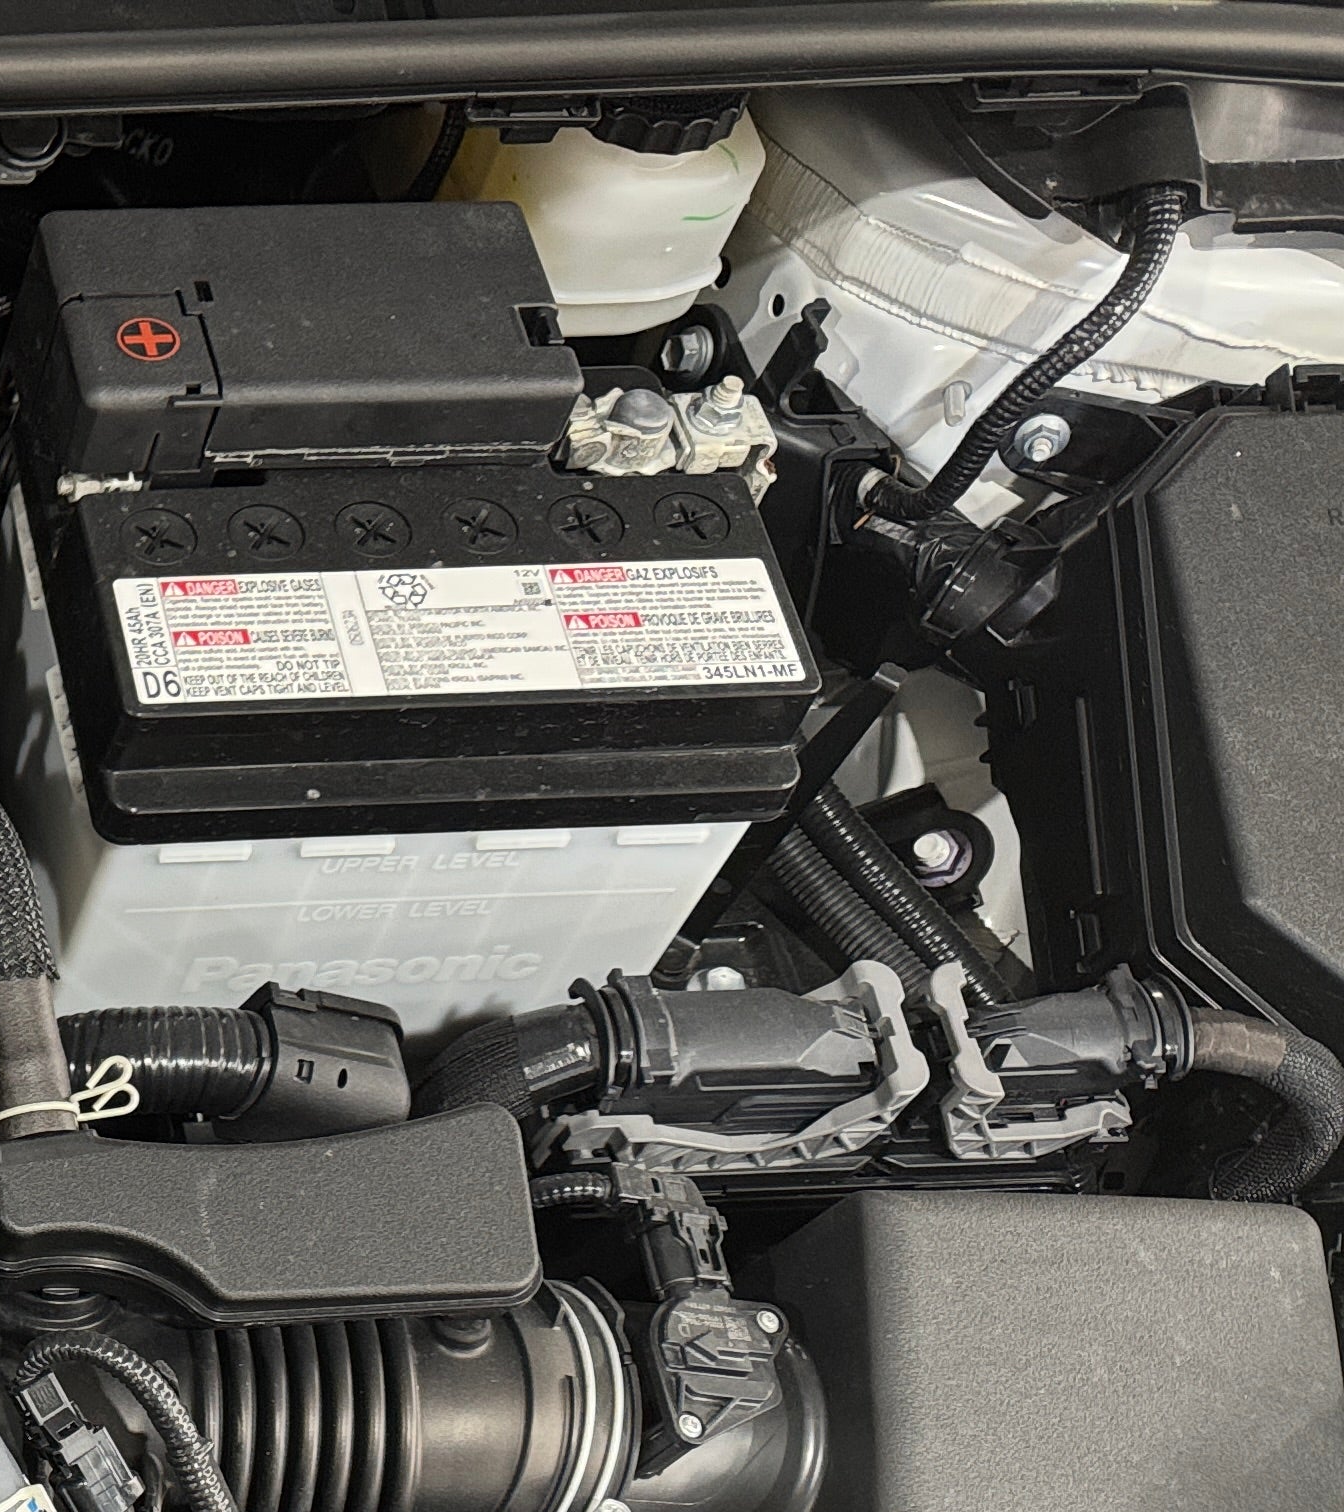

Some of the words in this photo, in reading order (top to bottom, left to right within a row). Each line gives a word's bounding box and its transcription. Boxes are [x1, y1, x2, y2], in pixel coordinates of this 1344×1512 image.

[514, 569, 540, 577] 12V
[575, 569, 624, 582] DANGER
[626, 569, 651, 581] GAZ
[186, 581, 235, 595] DANGER
[589, 614, 636, 628] POISON
[198, 631, 243, 644] POISON
[152, 643, 169, 665] CCA
[297, 660, 319, 670] NOT
[702, 663, 798, 679] 345LN1-MF
[143, 671, 181, 698] D6
[321, 854, 417, 876] UPPER
[434, 850, 520, 871] LEVEL
[296, 902, 397, 923] LOWER
[410, 898, 494, 918] LEVEL
[184, 946, 540, 993] Panasonic
